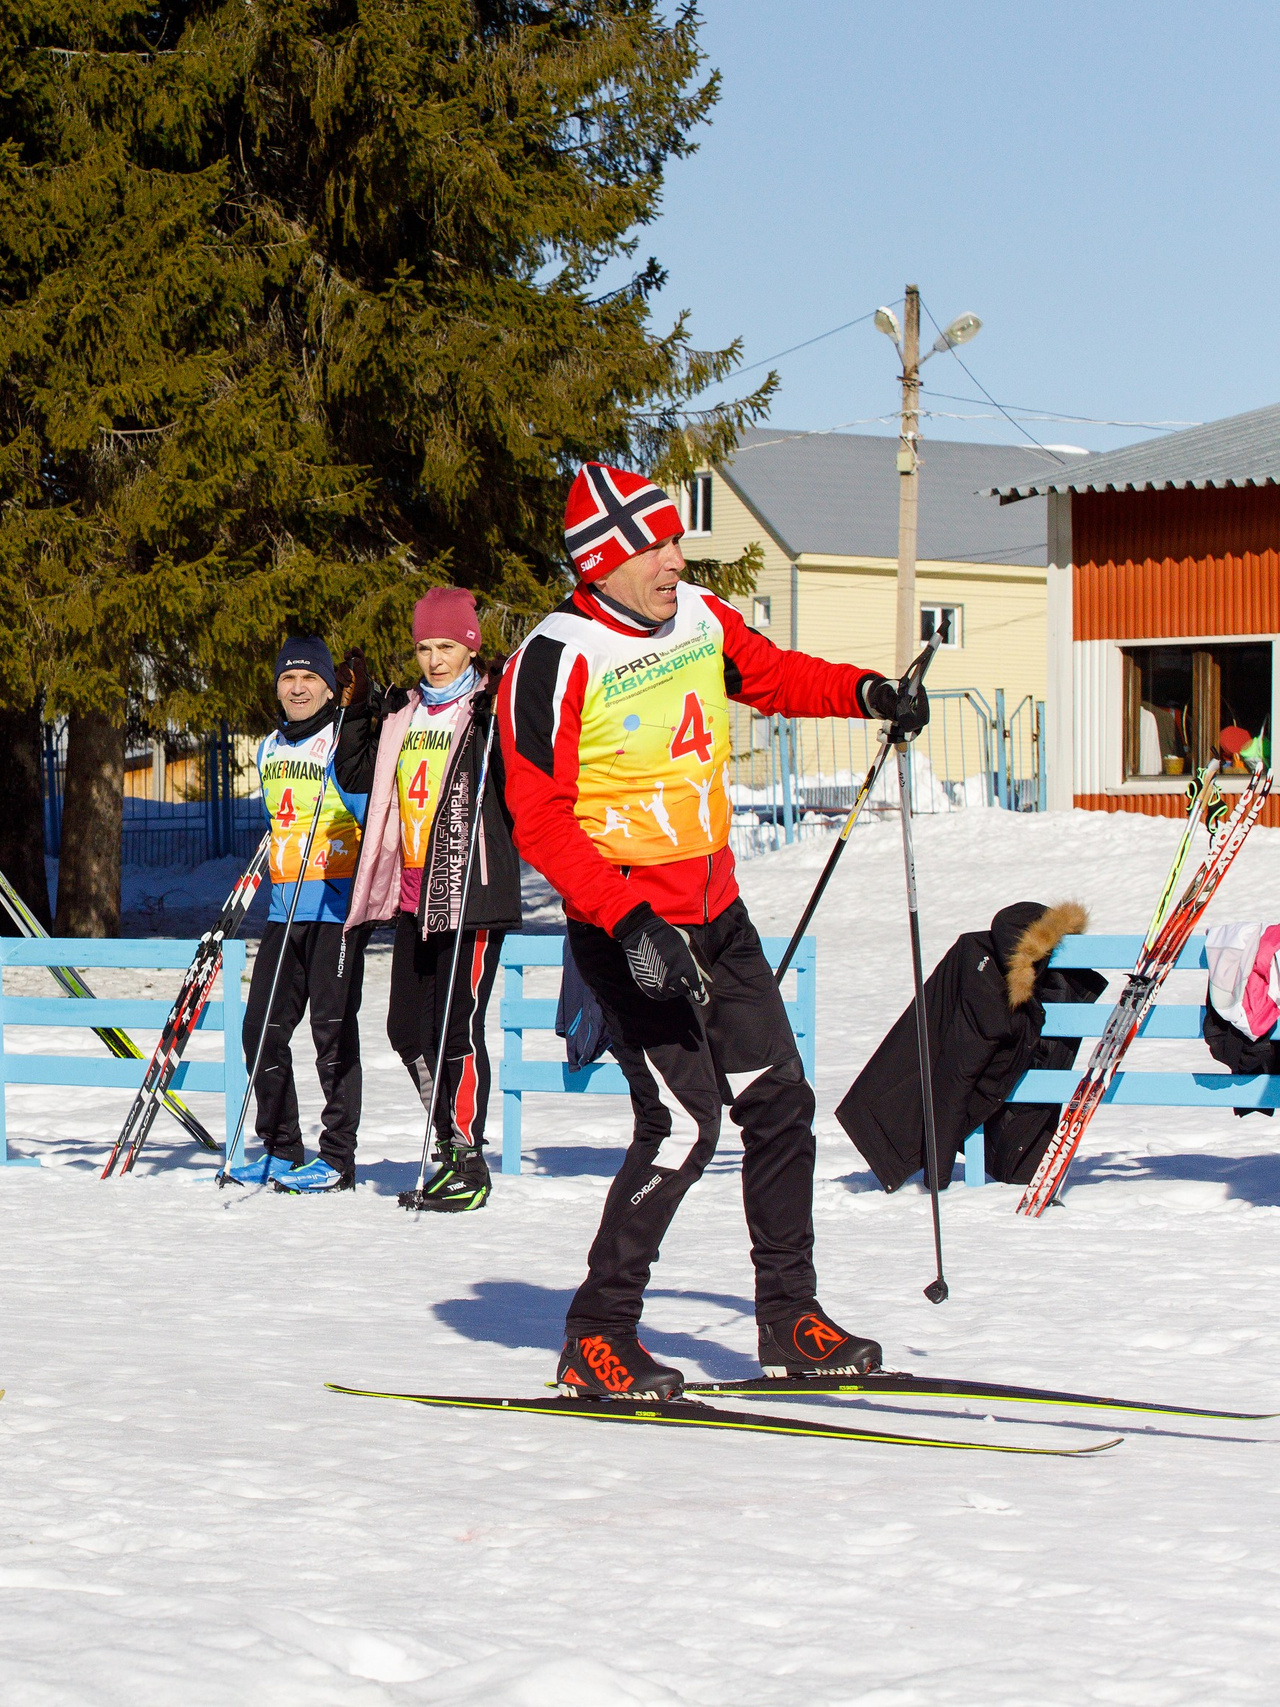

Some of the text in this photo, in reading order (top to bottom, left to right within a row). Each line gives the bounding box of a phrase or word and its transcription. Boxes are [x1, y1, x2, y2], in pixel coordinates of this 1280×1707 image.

[602, 652, 661, 686] #PRO
[670, 690, 713, 765] 4
[276, 788, 297, 828] 4
[408, 759, 429, 809] 4
[450, 782, 464, 894] MAKE IT SIMPLE
[1204, 789, 1253, 871] ATOMIC
[1217, 796, 1266, 876] ATOMIC
[314, 850, 328, 869] 4
[1136, 982, 1160, 1029] ATOMIC
[631, 1174, 662, 1205] BRIKO
[1025, 1120, 1069, 1204] ATOMIC
[1037, 1121, 1081, 1205] ATOMIC
[580, 1335, 635, 1392] ROSSI
